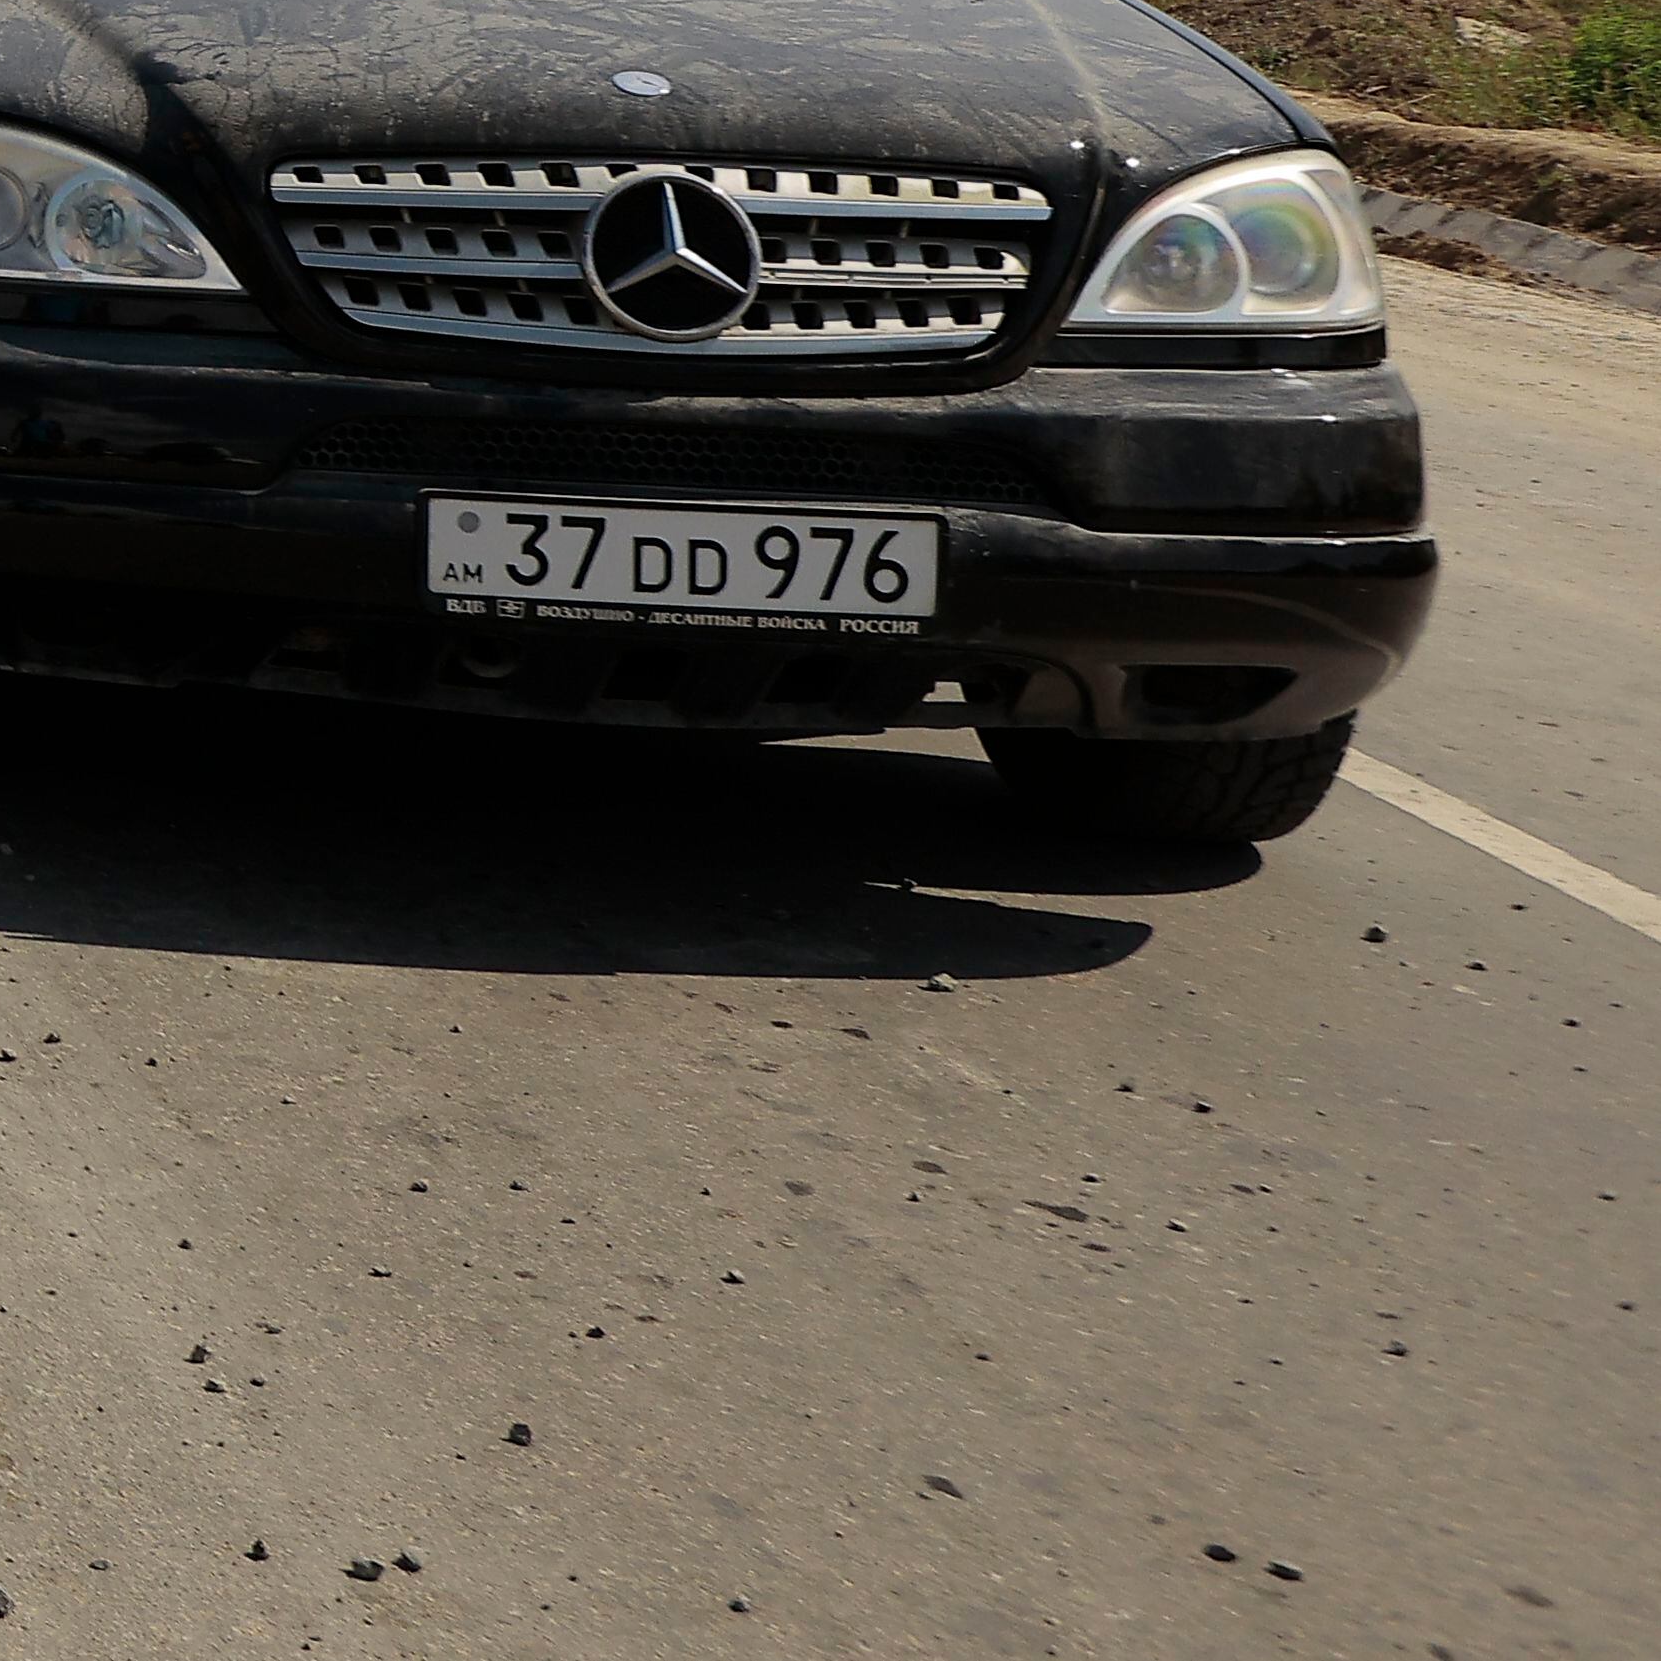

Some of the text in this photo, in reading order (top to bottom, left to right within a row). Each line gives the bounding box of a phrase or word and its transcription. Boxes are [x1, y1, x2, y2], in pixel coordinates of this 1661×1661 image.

[442, 562, 483, 584] AM
[505, 513, 910, 604] 37 DD 976
[536, 604, 635, 622] ВОЗДУШНО
[647, 611, 753, 628] ДЕСАНТНЫЕ
[757, 615, 828, 630] ВОЙСКА
[839, 618, 920, 635] РОССИЯ
